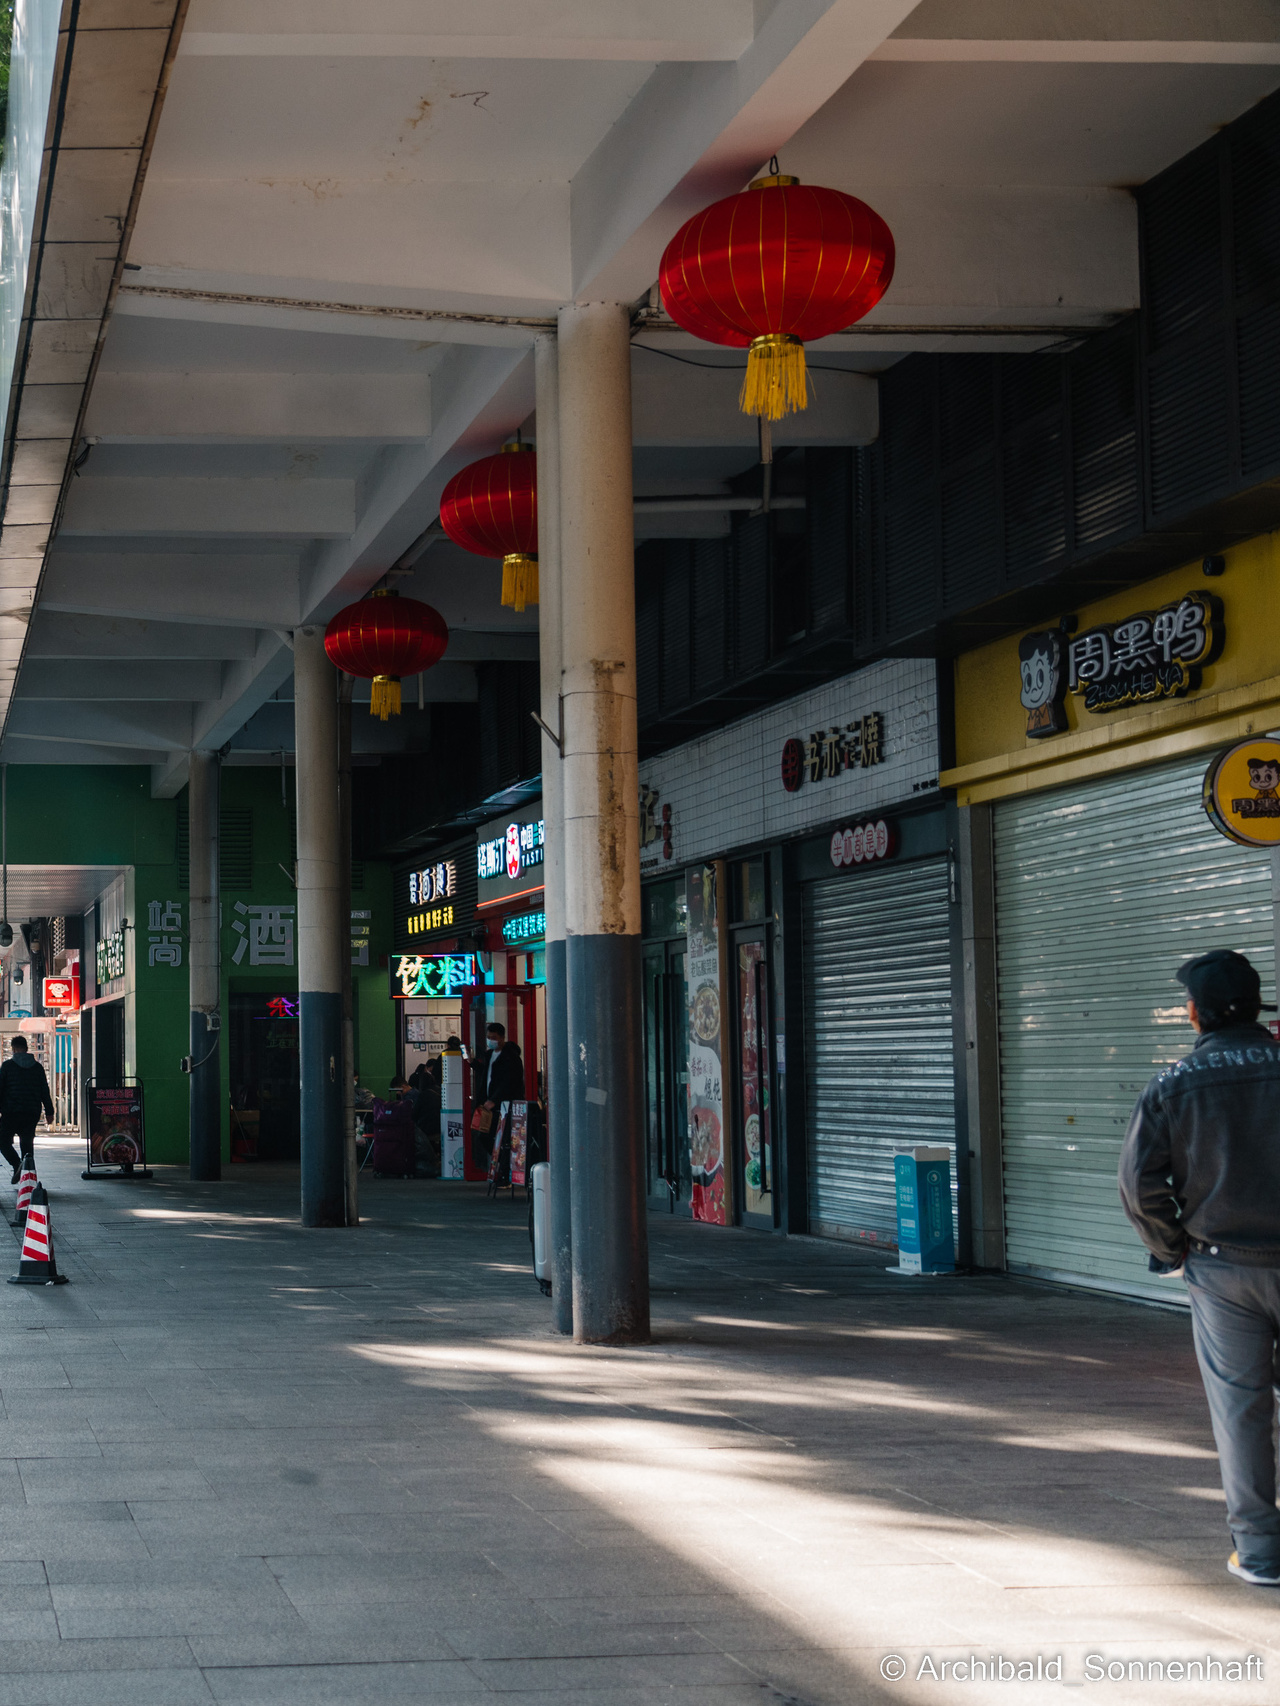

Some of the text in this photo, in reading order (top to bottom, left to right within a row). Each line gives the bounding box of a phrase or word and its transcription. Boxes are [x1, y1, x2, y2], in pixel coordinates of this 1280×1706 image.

[1070, 600, 1204, 686] 周黑鸭
[1087, 664, 1182, 704] ZHOU HEI YA
[1233, 799, 1280, 814] 周黑
[477, 837, 505, 879] 塔斯汀
[833, 825, 886, 862] 半杯都是料
[395, 955, 474, 996] 饮料
